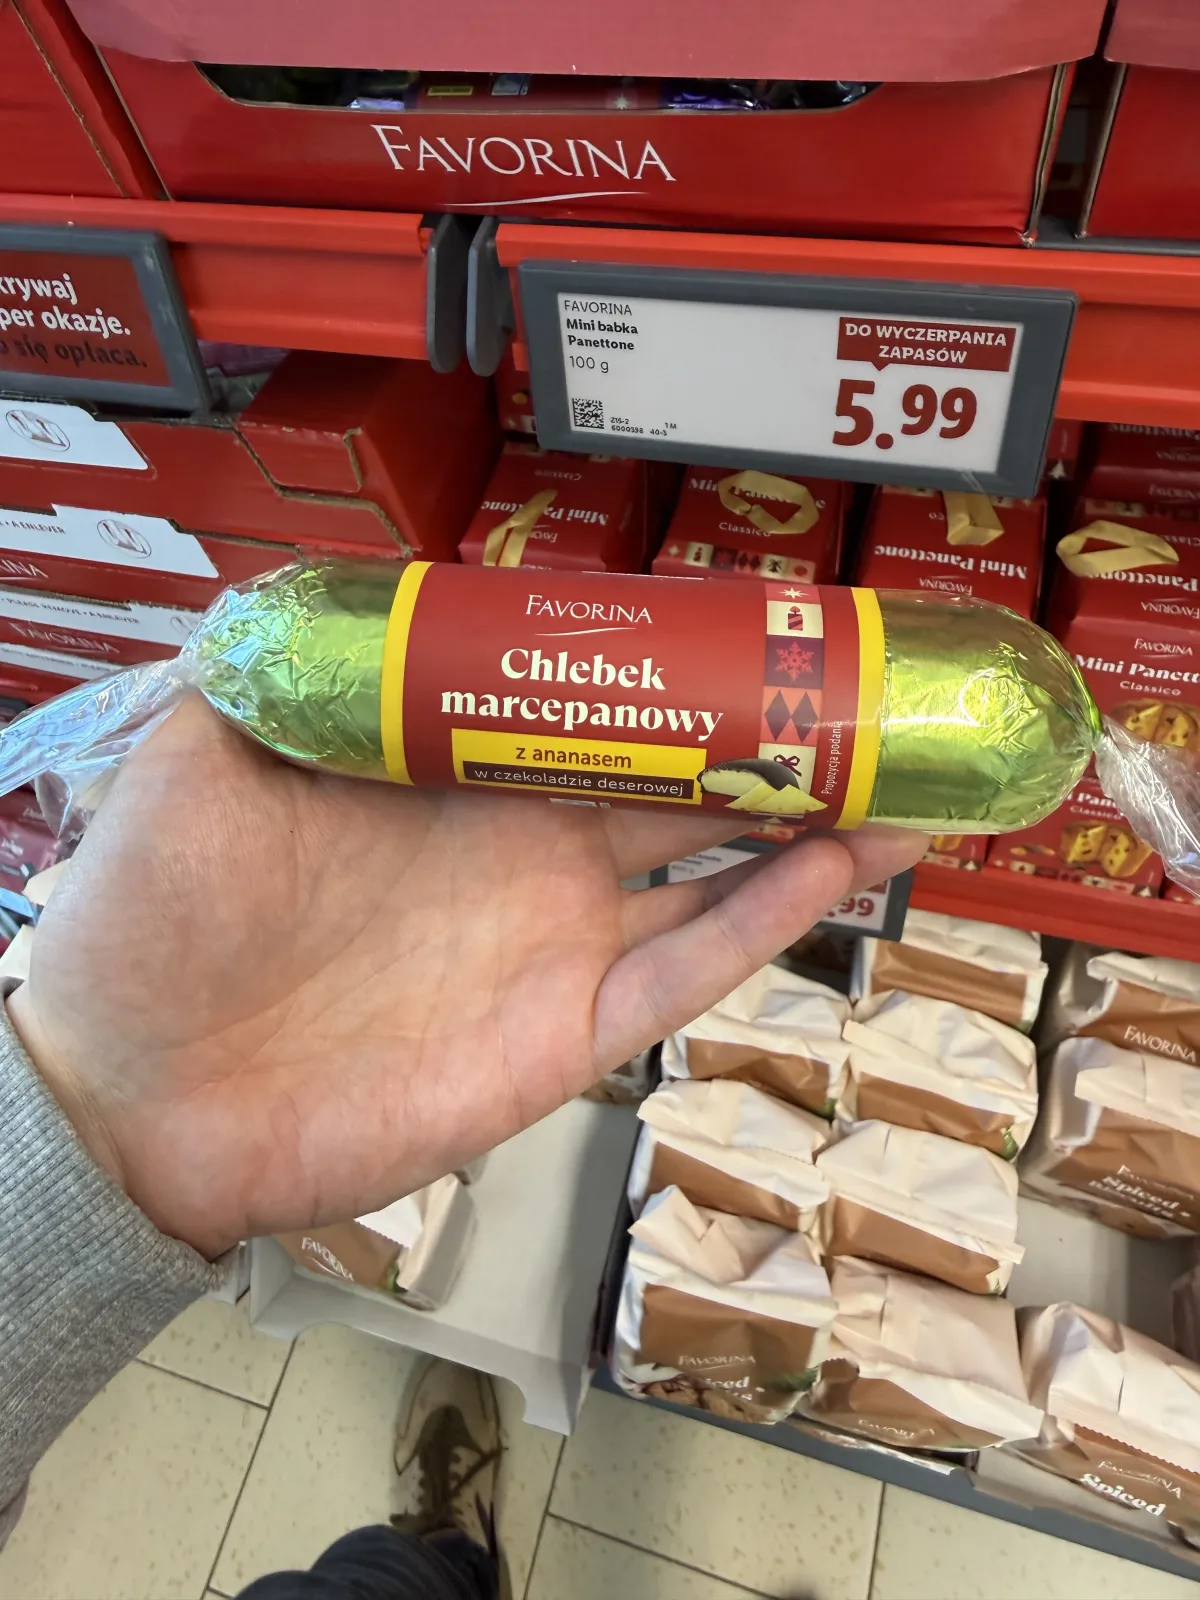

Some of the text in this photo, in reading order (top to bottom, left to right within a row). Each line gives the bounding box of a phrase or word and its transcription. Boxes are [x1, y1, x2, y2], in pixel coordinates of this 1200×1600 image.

[370, 124, 677, 182] FAVORINA
[564, 300, 632, 316] FAVORINA
[41, 305, 131, 339] okazje.
[566, 318, 638, 335] Mini babka
[568, 335, 635, 350] Panettone
[845, 323, 1007, 346] DO WYCZERPANIA
[569, 356, 609, 373] 100 g
[879, 344, 968, 364] ZAPASÓW
[832, 379, 978, 450] 5.99
[689, 478, 718, 492] Mi
[481, 500, 609, 526] Mini Patone
[875, 545, 1027, 580] Mini Panettone
[919, 577, 972, 596] FAVORINA
[1090, 570, 1198, 592] Panetton
[526, 594, 653, 624] FAVORINA
[1134, 638, 1193, 656] FAVORINA
[501, 648, 666, 690] Chlebek
[1075, 654, 1125, 674] Mini
[1119, 680, 1182, 696] Classico
[441, 690, 724, 741] marcepanowy
[516, 747, 632, 769] z ananasem
[474, 769, 684, 797] w czekoladzie deserowej
[820, 756, 841, 795] Propozycja
[1124, 1024, 1196, 1063] FAVORINA
